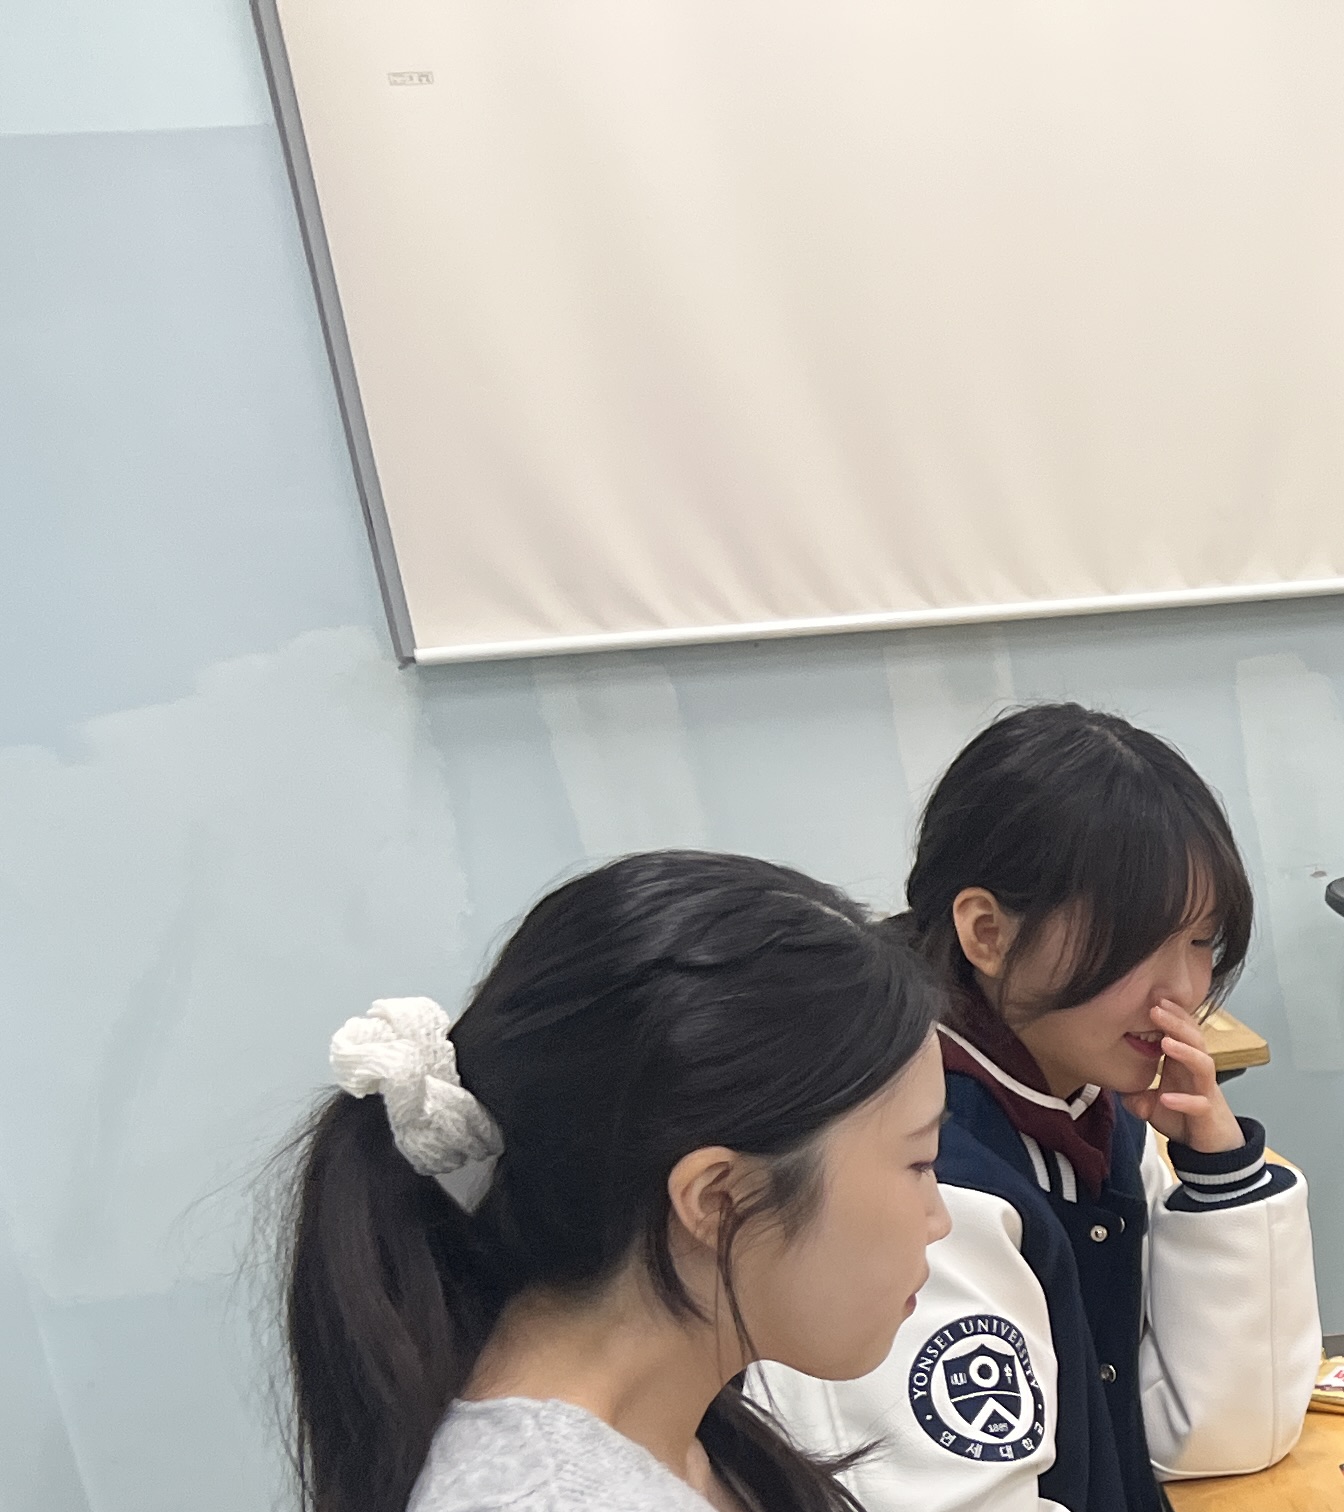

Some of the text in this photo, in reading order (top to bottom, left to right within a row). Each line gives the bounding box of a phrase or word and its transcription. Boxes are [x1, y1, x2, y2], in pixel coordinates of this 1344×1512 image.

[913, 1319, 1040, 1400] YONSEI UNIVERSITY
[940, 1421, 1044, 1459] 연세대학교
